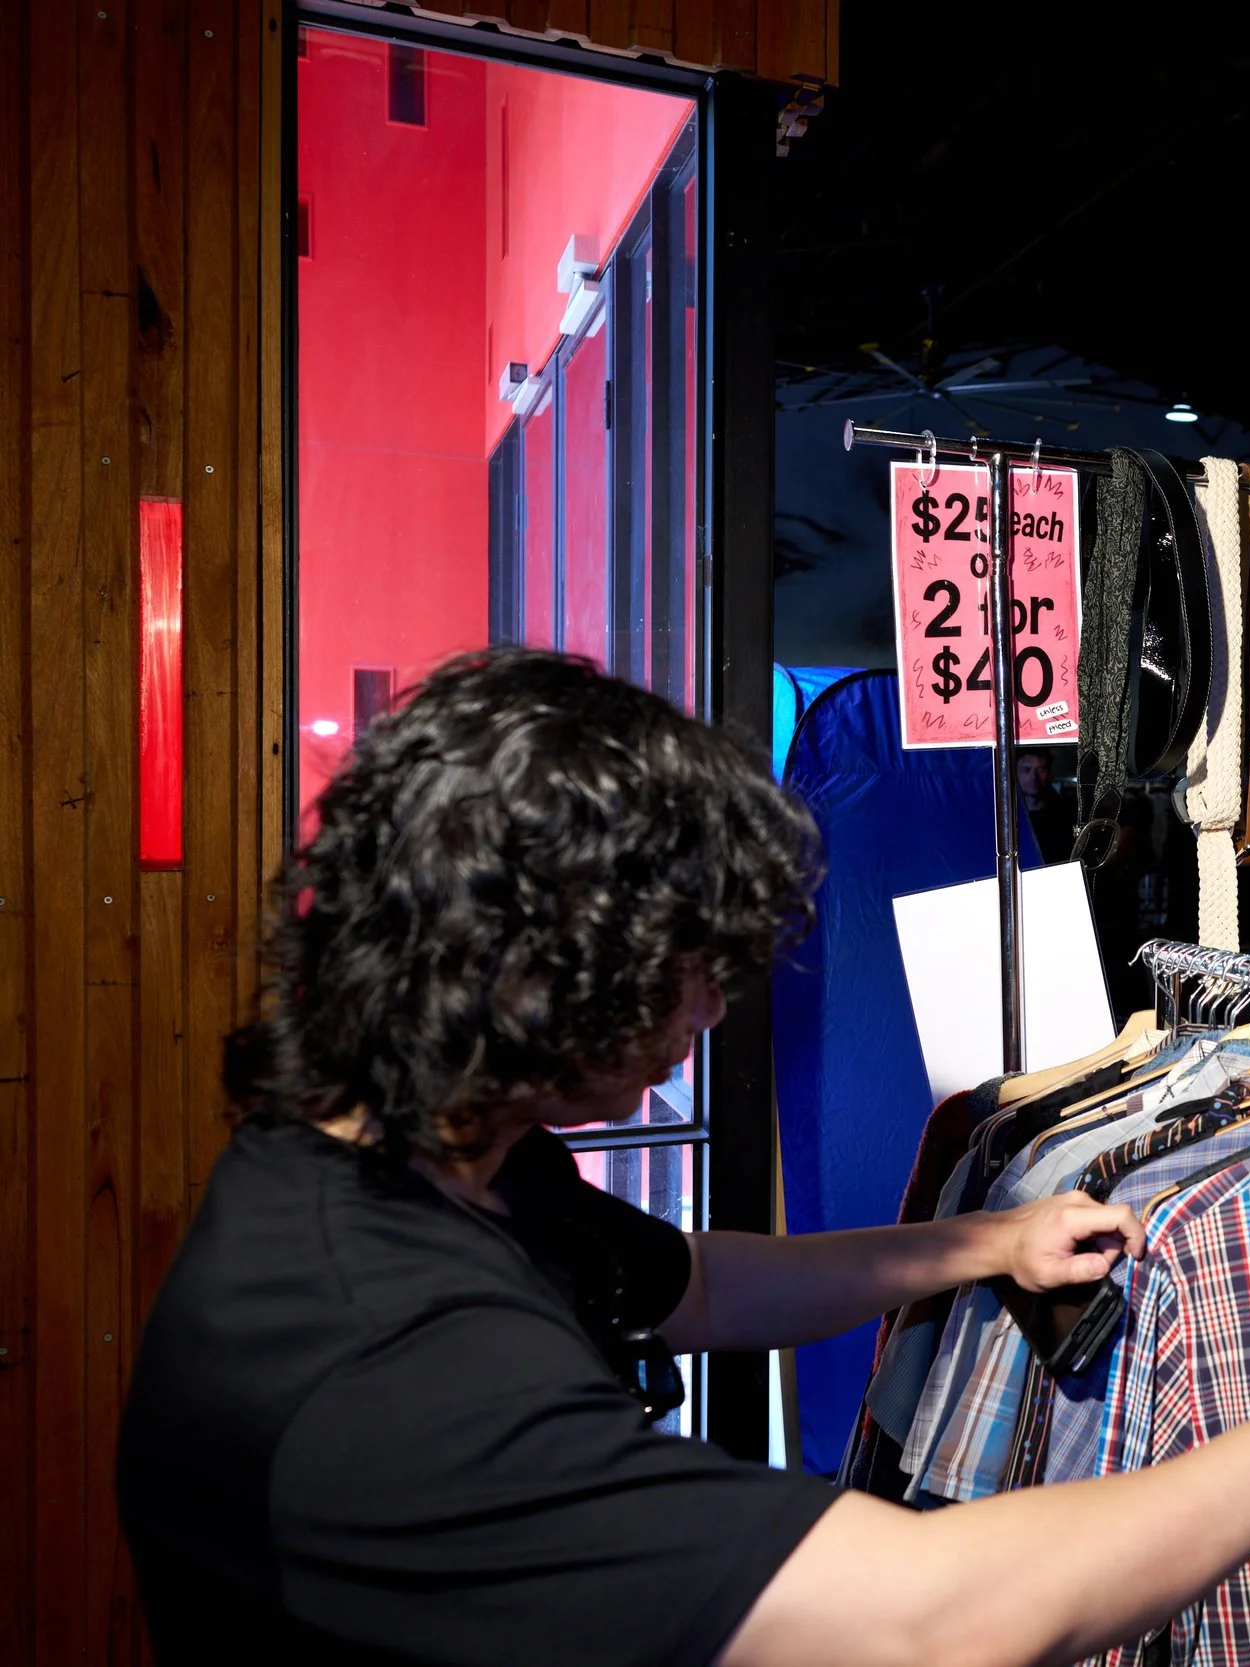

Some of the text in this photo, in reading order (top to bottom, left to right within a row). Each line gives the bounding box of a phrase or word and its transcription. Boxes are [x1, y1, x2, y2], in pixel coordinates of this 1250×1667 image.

[1010, 511, 1064, 543] each
[923, 579, 961, 638] 2
[931, 646, 1053, 707] $40
[1040, 705, 1064, 717] unless
